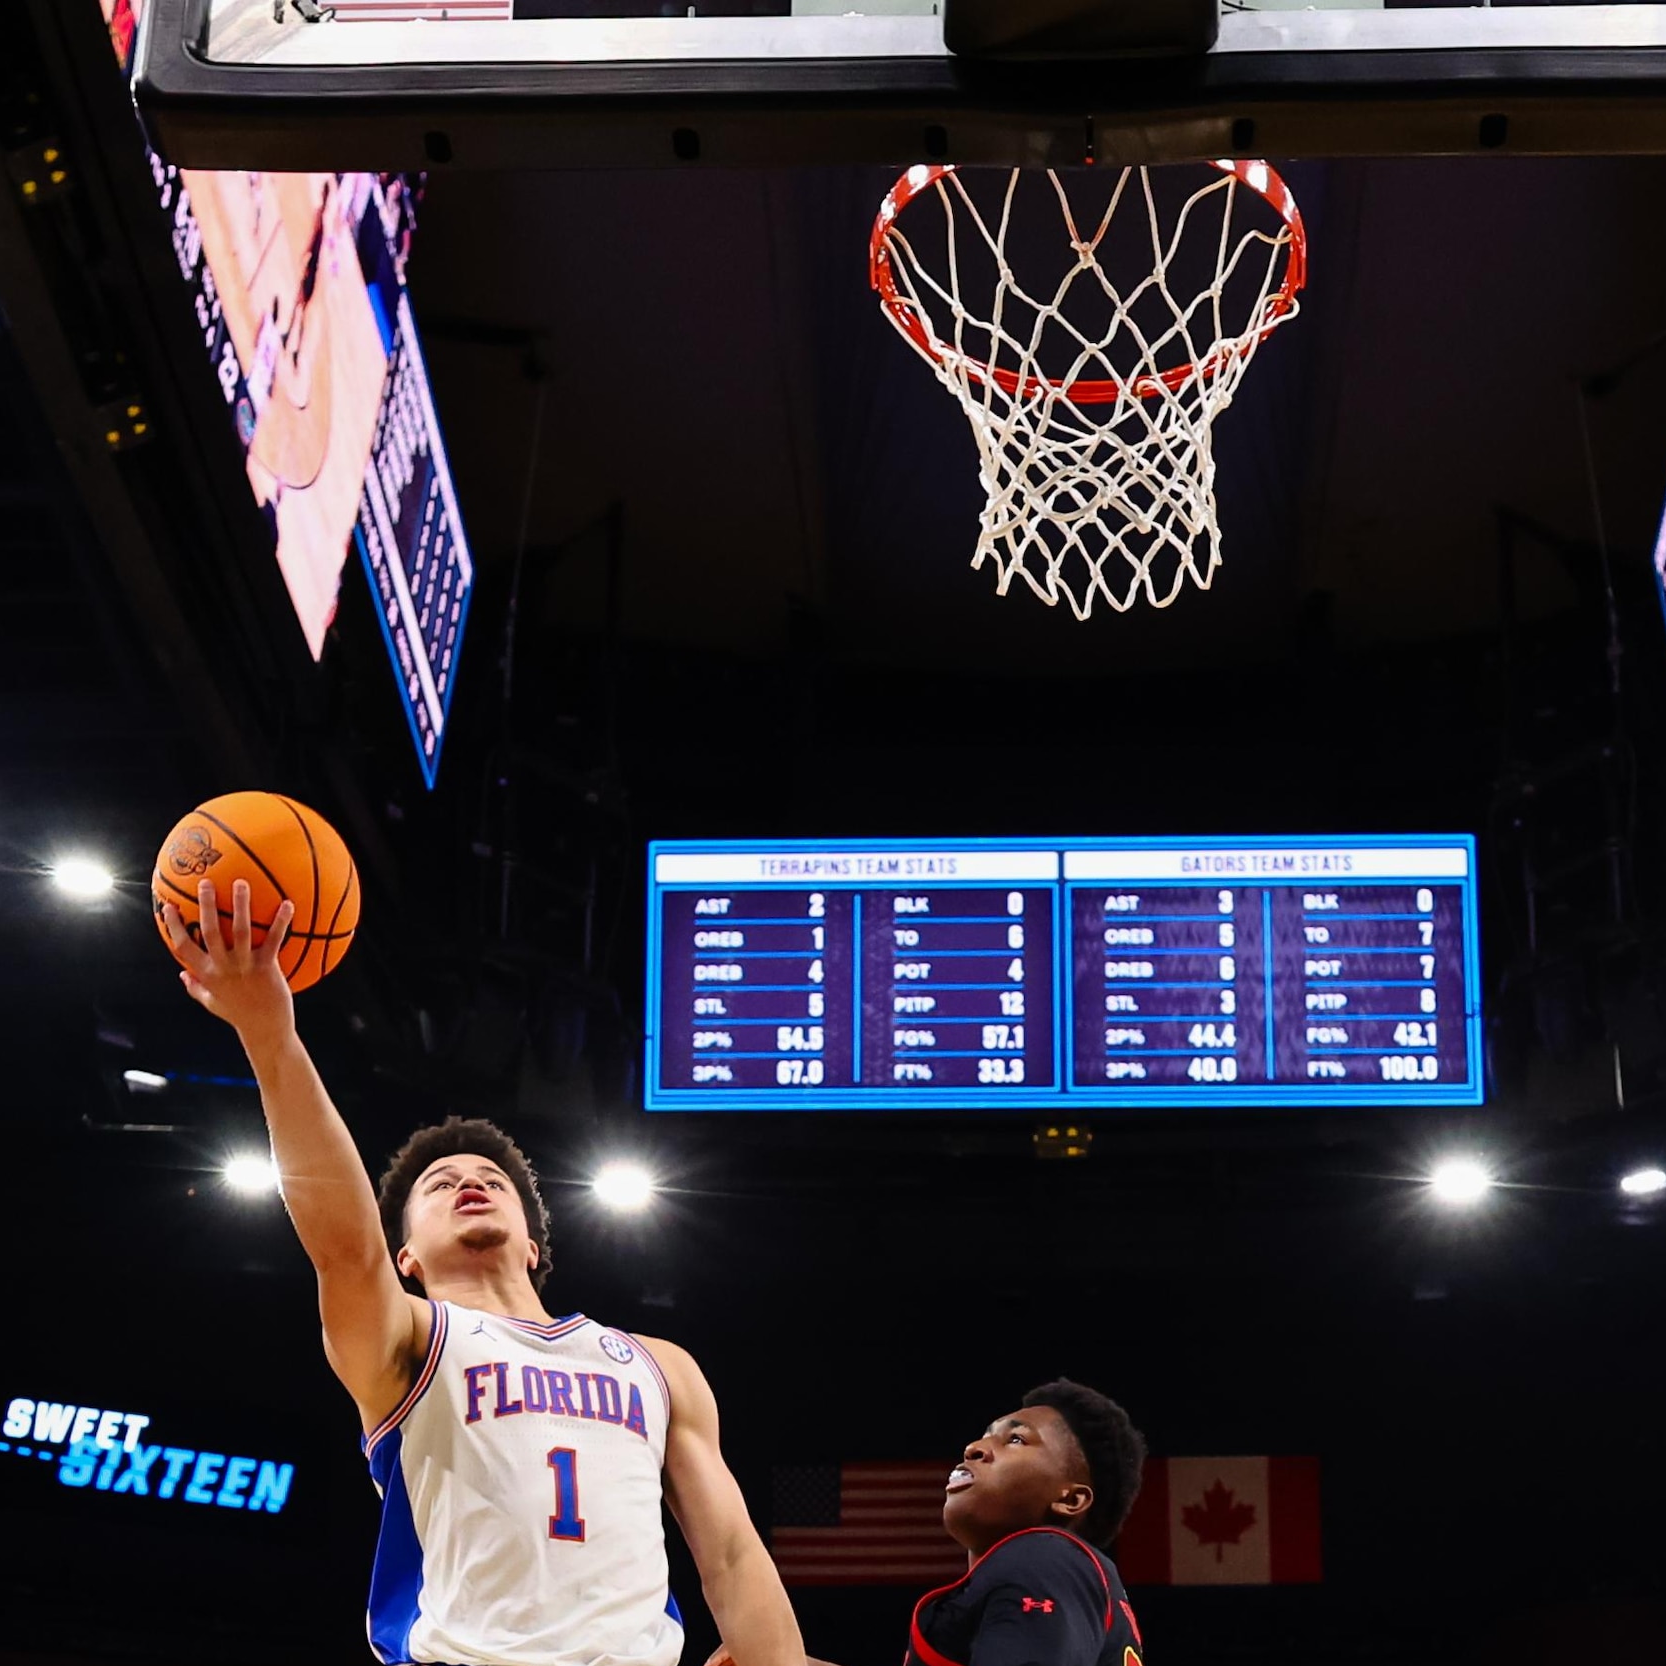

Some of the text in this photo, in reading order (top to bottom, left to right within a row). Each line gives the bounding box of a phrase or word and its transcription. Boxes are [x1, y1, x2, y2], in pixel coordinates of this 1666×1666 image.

[760, 857, 958, 877] TERRAPINS TEAM STATS
[1181, 854, 1353, 873] GATORS TEAM STATS
[695, 893, 825, 917] AST 2
[894, 897, 929, 913] BLK
[1104, 890, 1234, 914] AST 3
[1303, 893, 1339, 910] BLK
[812, 926, 824, 950] 1
[893, 930, 919, 946] TO
[1219, 922, 1235, 947] 5
[1304, 921, 1434, 946] TO 7
[808, 959, 824, 983] 4
[893, 958, 1024, 982] POT 4
[1304, 954, 1435, 979] POT 7
[694, 992, 824, 1017] STL 5
[999, 991, 1025, 1016] 12
[1105, 989, 1236, 1014] STL 3
[777, 1026, 824, 1051] 54.5
[982, 1024, 1024, 1049] 57.1
[1188, 1023, 1237, 1048] 44.4
[1393, 1022, 1437, 1047] 42.1
[776, 1059, 824, 1085] 67.0
[978, 1058, 1025, 1083] 33.3
[1187, 1057, 1237, 1082] 40.0
[1379, 1055, 1438, 1081] 100.0
[464, 1361, 649, 1441] FLORIDA
[2, 1397, 150, 1453] SWEET
[59, 1435, 294, 1514] SIXTEEN
[547, 1446, 585, 1543] 1
